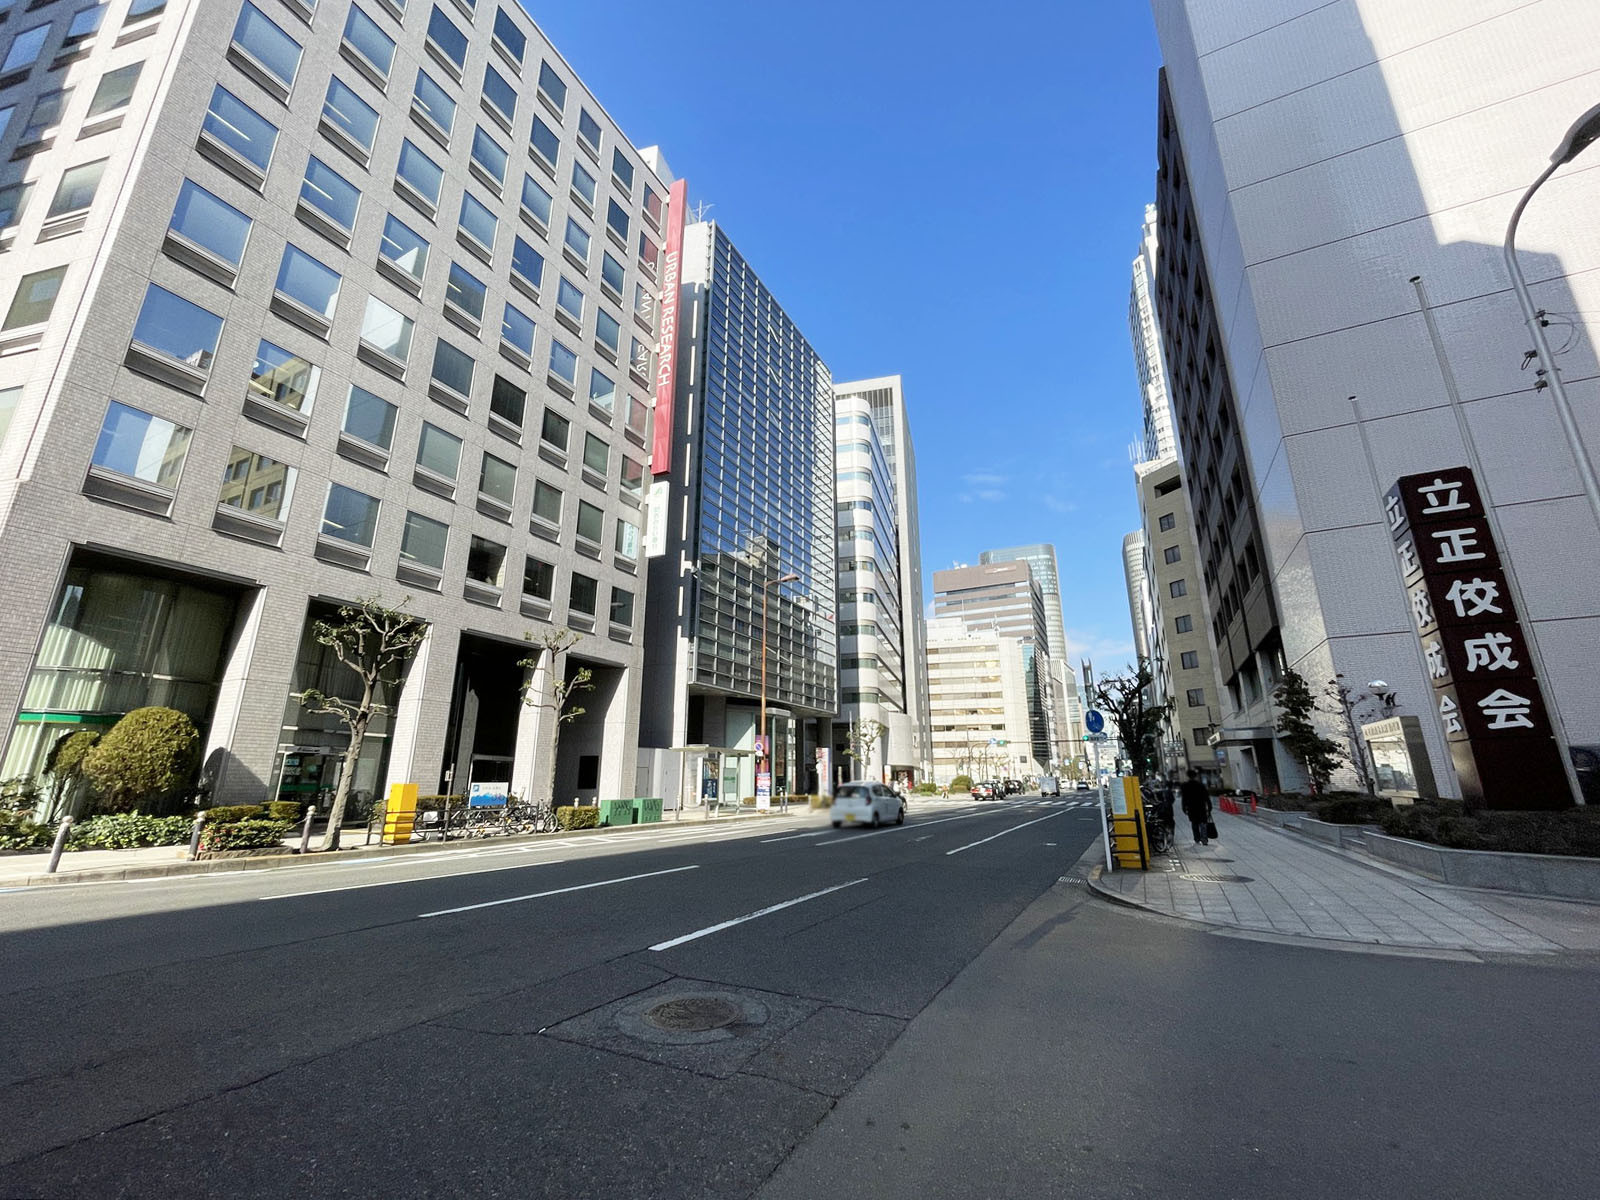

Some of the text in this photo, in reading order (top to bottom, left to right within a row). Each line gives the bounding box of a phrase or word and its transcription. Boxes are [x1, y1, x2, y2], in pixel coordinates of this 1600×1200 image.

[659, 252, 678, 386] URBAN RESEARCH
[1417, 478, 1534, 729] 立正佼成会
